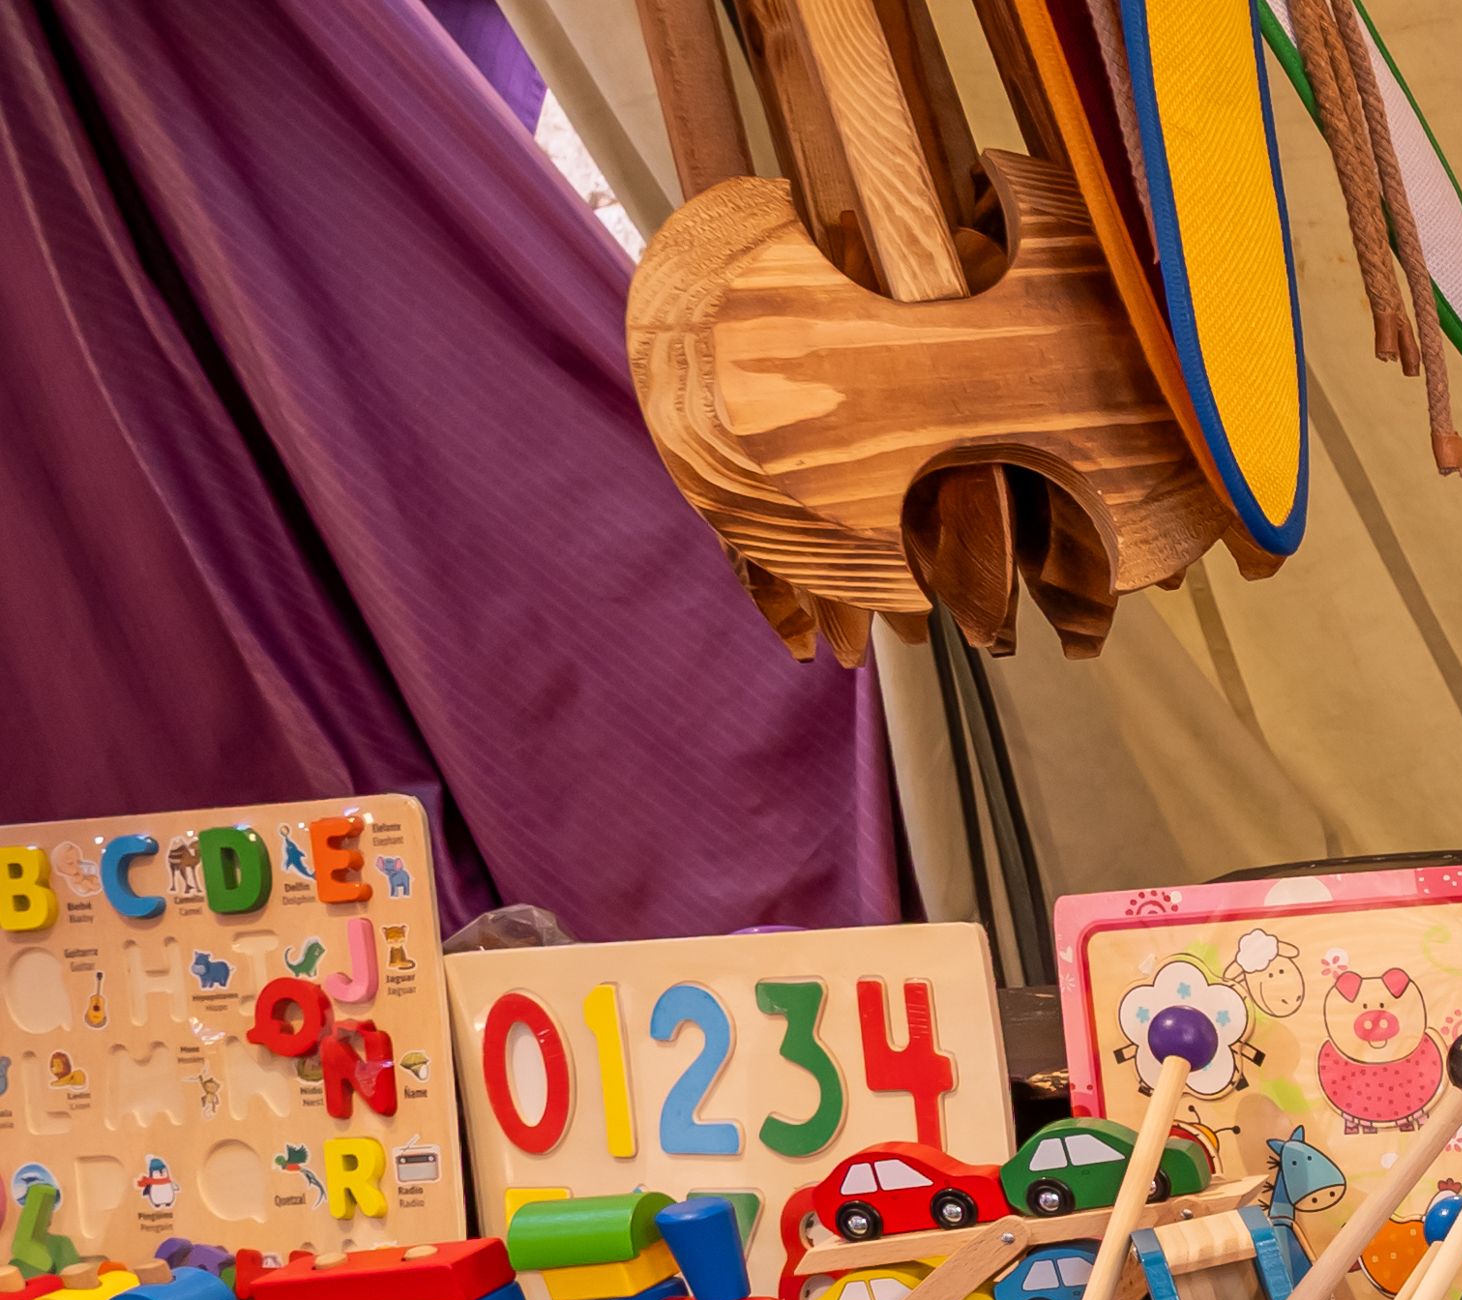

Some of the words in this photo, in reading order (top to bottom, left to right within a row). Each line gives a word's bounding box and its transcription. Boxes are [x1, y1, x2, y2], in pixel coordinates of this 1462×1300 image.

[0, 845, 58, 932] B
[101, 834, 167, 919] C
[199, 826, 272, 915] D
[310, 815, 373, 904] E
[325, 917, 379, 1003] J
[482, 990, 572, 1156] 0
[583, 983, 638, 1159] 1
[650, 983, 743, 1157] 2
[755, 980, 848, 1157] 3
[856, 978, 956, 1149] 4
[323, 1136, 388, 1220] R
